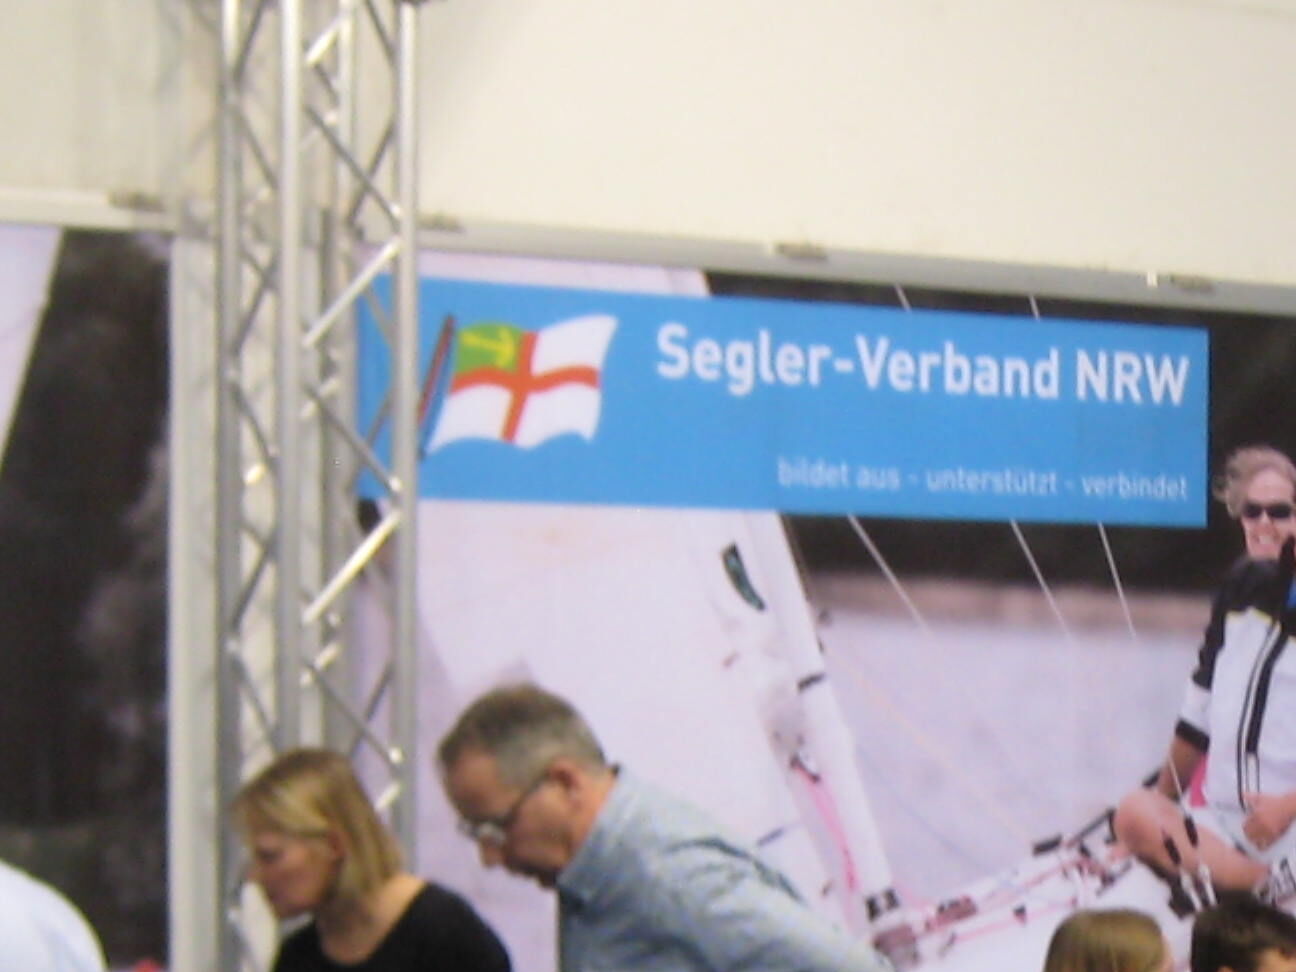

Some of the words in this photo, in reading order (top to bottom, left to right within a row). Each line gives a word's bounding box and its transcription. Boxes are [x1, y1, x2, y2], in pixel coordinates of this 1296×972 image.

[655, 321, 1061, 399] Segler-Verband
[1075, 349, 1190, 405] NRW
[777, 457, 849, 490] bildet
[856, 465, 900, 489] aus
[926, 466, 1058, 495] unterstützt
[1082, 472, 1188, 501] verbindet
